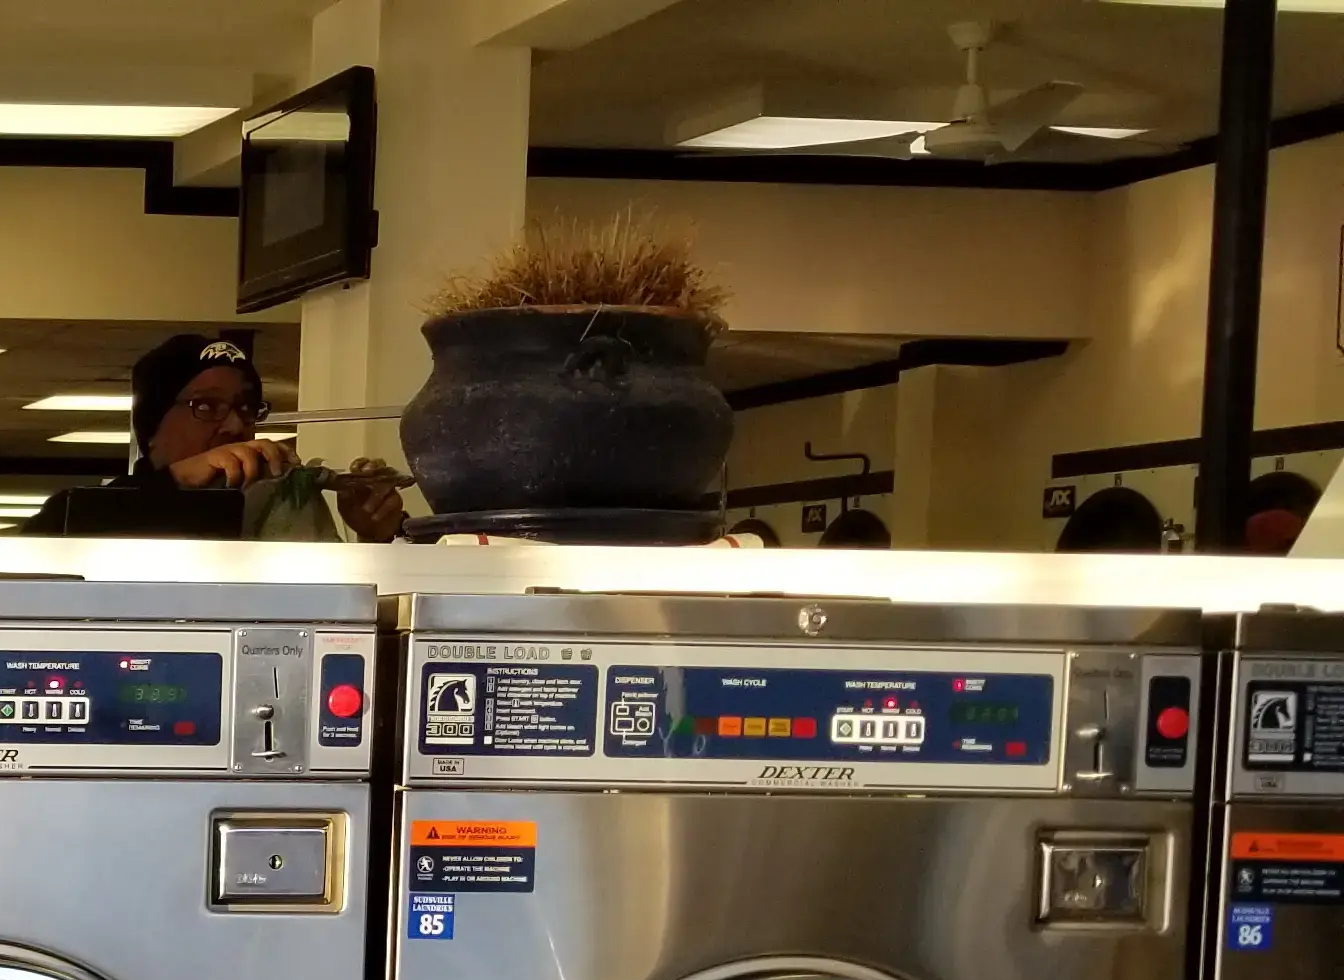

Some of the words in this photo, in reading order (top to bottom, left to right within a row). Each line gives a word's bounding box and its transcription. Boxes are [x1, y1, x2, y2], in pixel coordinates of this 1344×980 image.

[242, 645, 280, 655] Quarters
[283, 646, 303, 658] Only
[428, 645, 496, 659] DOUBLE
[504, 647, 550, 660] LOAD
[6, 662, 28, 670] WASH
[29, 662, 80, 670] TEMPERATURE
[743, 679, 766, 687] CYCLE
[759, 766, 855, 780] DEXTER
[414, 896, 453, 904] SUDSVILLE
[413, 904, 452, 912] LAUNDRIES
[420, 914, 444, 935] 85
[1239, 924, 1263, 945] 86
